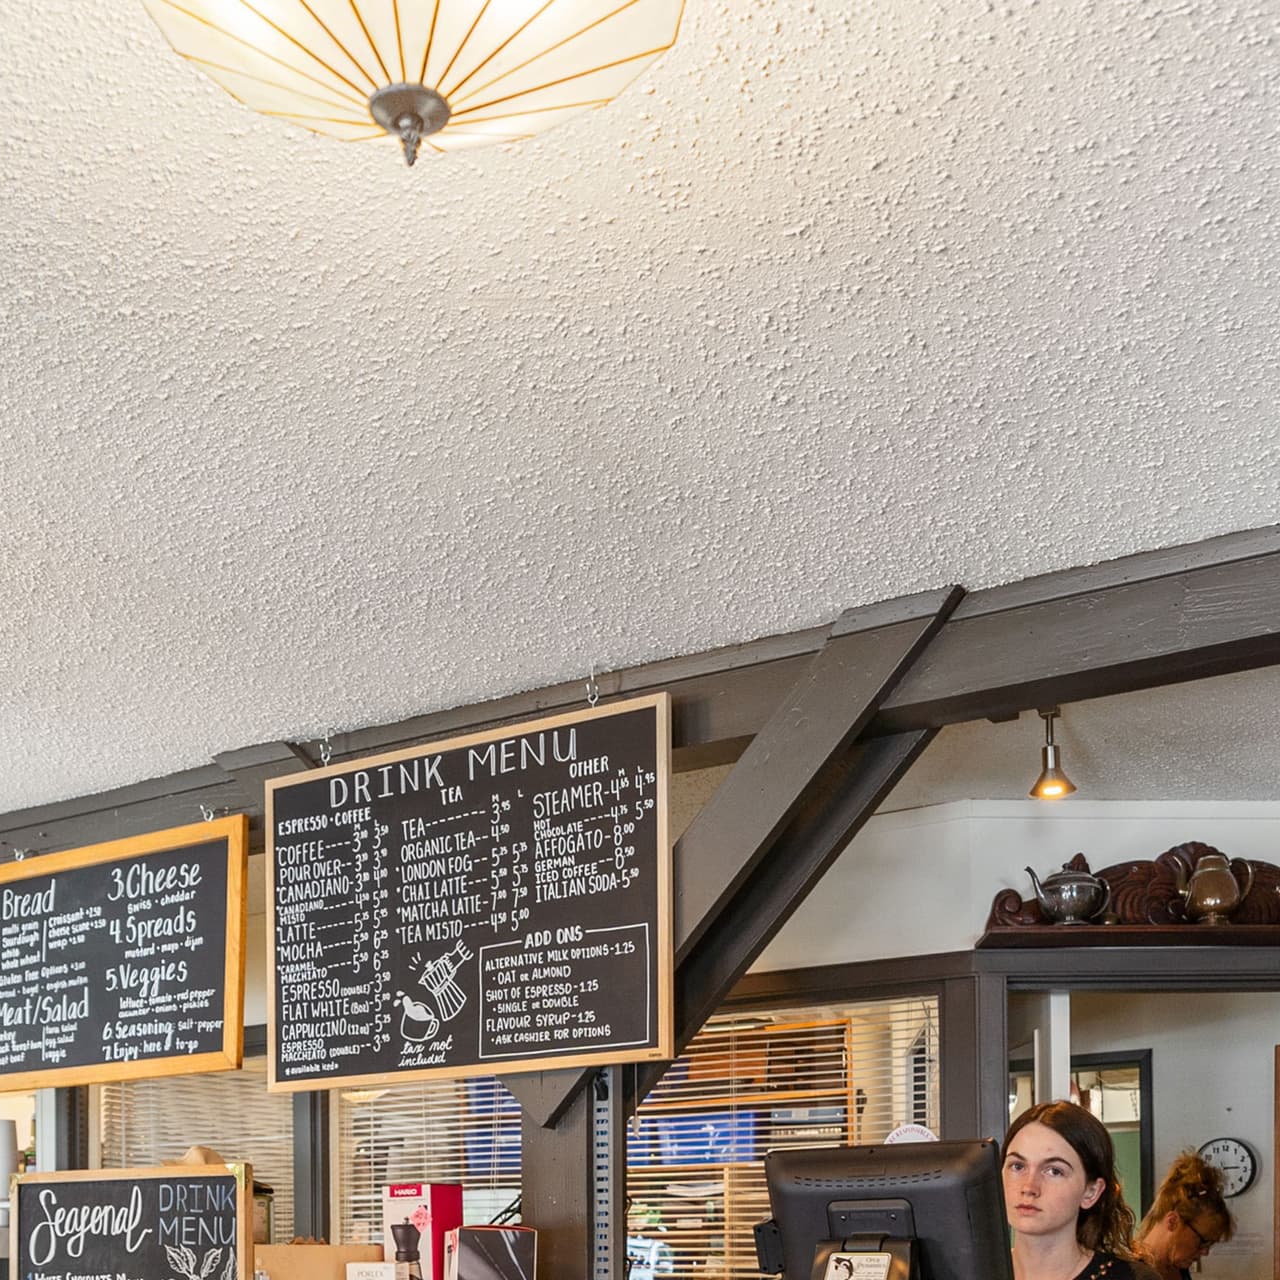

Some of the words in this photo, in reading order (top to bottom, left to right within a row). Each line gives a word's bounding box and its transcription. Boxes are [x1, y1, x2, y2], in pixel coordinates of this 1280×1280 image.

[329, 755, 444, 808] DRINK
[469, 728, 577, 780] MENU
[570, 756, 609, 778] OTHER
[440, 785, 463, 805] TEA
[533, 781, 604, 819] STEAMER
[278, 815, 328, 836] ESPRESSO
[335, 807, 371, 827] COFFEE
[401, 817, 425, 841] TEA
[534, 818, 551, 831] HOT
[534, 821, 583, 841] CHOCOLATE
[278, 840, 324, 866] COFFEE
[400, 836, 452, 863] ORGANIC
[454, 830, 476, 848] TEA
[535, 828, 603, 860] AFFOGATO
[280, 864, 312, 885] POUR
[314, 859, 342, 879] OVER
[401, 858, 445, 883] LONDON
[448, 854, 472, 874] FOG
[535, 855, 575, 872] GERMAN
[535, 870, 559, 884] ICED
[562, 862, 597, 879] COFFEE
[126, 862, 202, 899] Cheese
[279, 876, 349, 904] CANADIANO
[402, 882, 430, 903] CHAI
[434, 875, 467, 898] LATTE
[535, 881, 586, 903] ITALIAN
[588, 872, 617, 894] SODA
[4, 878, 56, 920] Bread
[161, 890, 196, 907] cheddar
[402, 900, 449, 923] MATCHA
[452, 895, 481, 916] LATTE
[126, 905, 196, 946] Spreads
[280, 922, 316, 944] LATTE
[400, 925, 422, 944] TEA
[426, 919, 463, 941] MISTO
[524, 931, 552, 949] ADD
[556, 925, 583, 944] ONS
[280, 941, 323, 962] MOCHA
[485, 953, 544, 971] ALTERNATIVE
[547, 950, 569, 963] MILK
[570, 944, 609, 960] OPTIONS
[119, 960, 187, 997] Veggies
[498, 971, 516, 985] OAT
[531, 966, 571, 981] ALMOND
[282, 978, 340, 1003] ESPRESSO
[486, 988, 508, 1002] SHOT
[511, 987, 521, 1000] OF
[525, 983, 572, 999] ESPRESSO
[282, 1002, 309, 1021] FLAT
[311, 998, 350, 1018] WHITE
[497, 1000, 527, 1014] SINGLE
[542, 995, 579, 1010] DOUBLE
[282, 1018, 347, 1041] CAPPUCCINO
[486, 1015, 531, 1033] FLAVOUR
[536, 1012, 570, 1027] SYRUP
[495, 1034, 512, 1045] ASK
[514, 1031, 551, 1043] CASHIER
[554, 1028, 569, 1040] FOR
[572, 1024, 611, 1038] OPTIONS
[400, 1041, 424, 1055] tax
[428, 1034, 453, 1051] not
[398, 1051, 446, 1068] included
[159, 1184, 236, 1213] DRINK
[394, 1188, 418, 1196] HARIO
[29, 1185, 152, 1265] Seasonal
[159, 1217, 236, 1245] MENU
